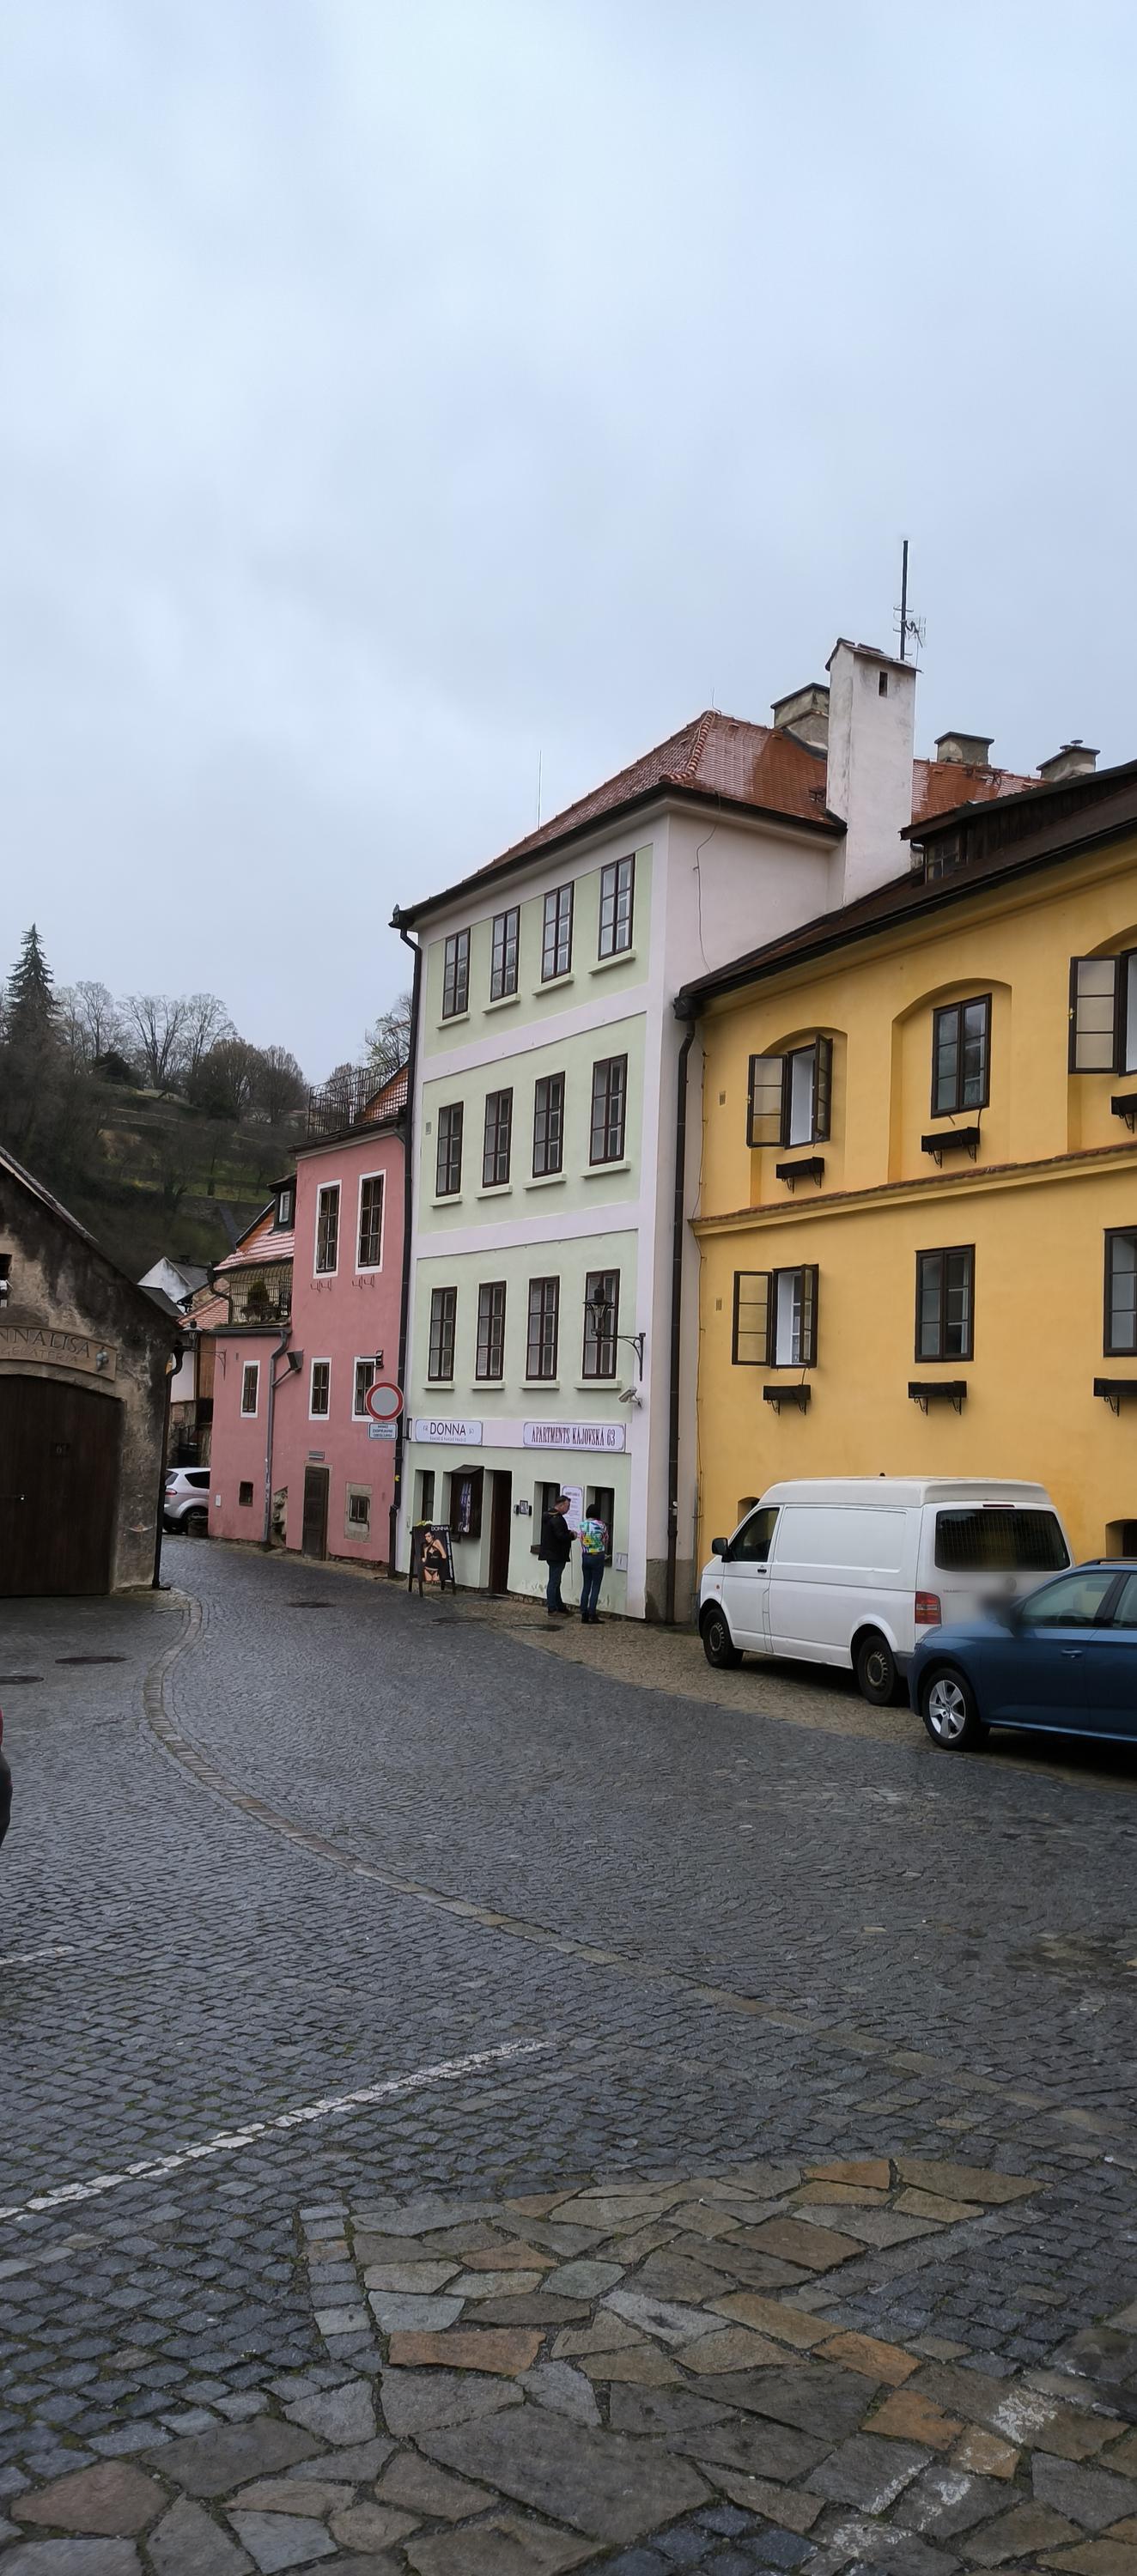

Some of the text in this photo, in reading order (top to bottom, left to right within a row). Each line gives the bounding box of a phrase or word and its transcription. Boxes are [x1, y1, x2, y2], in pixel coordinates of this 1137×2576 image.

[430, 1422, 466, 1437] DONNA
[532, 1426, 616, 1446] APARTMENTS KÁJOVSKÁ 63
